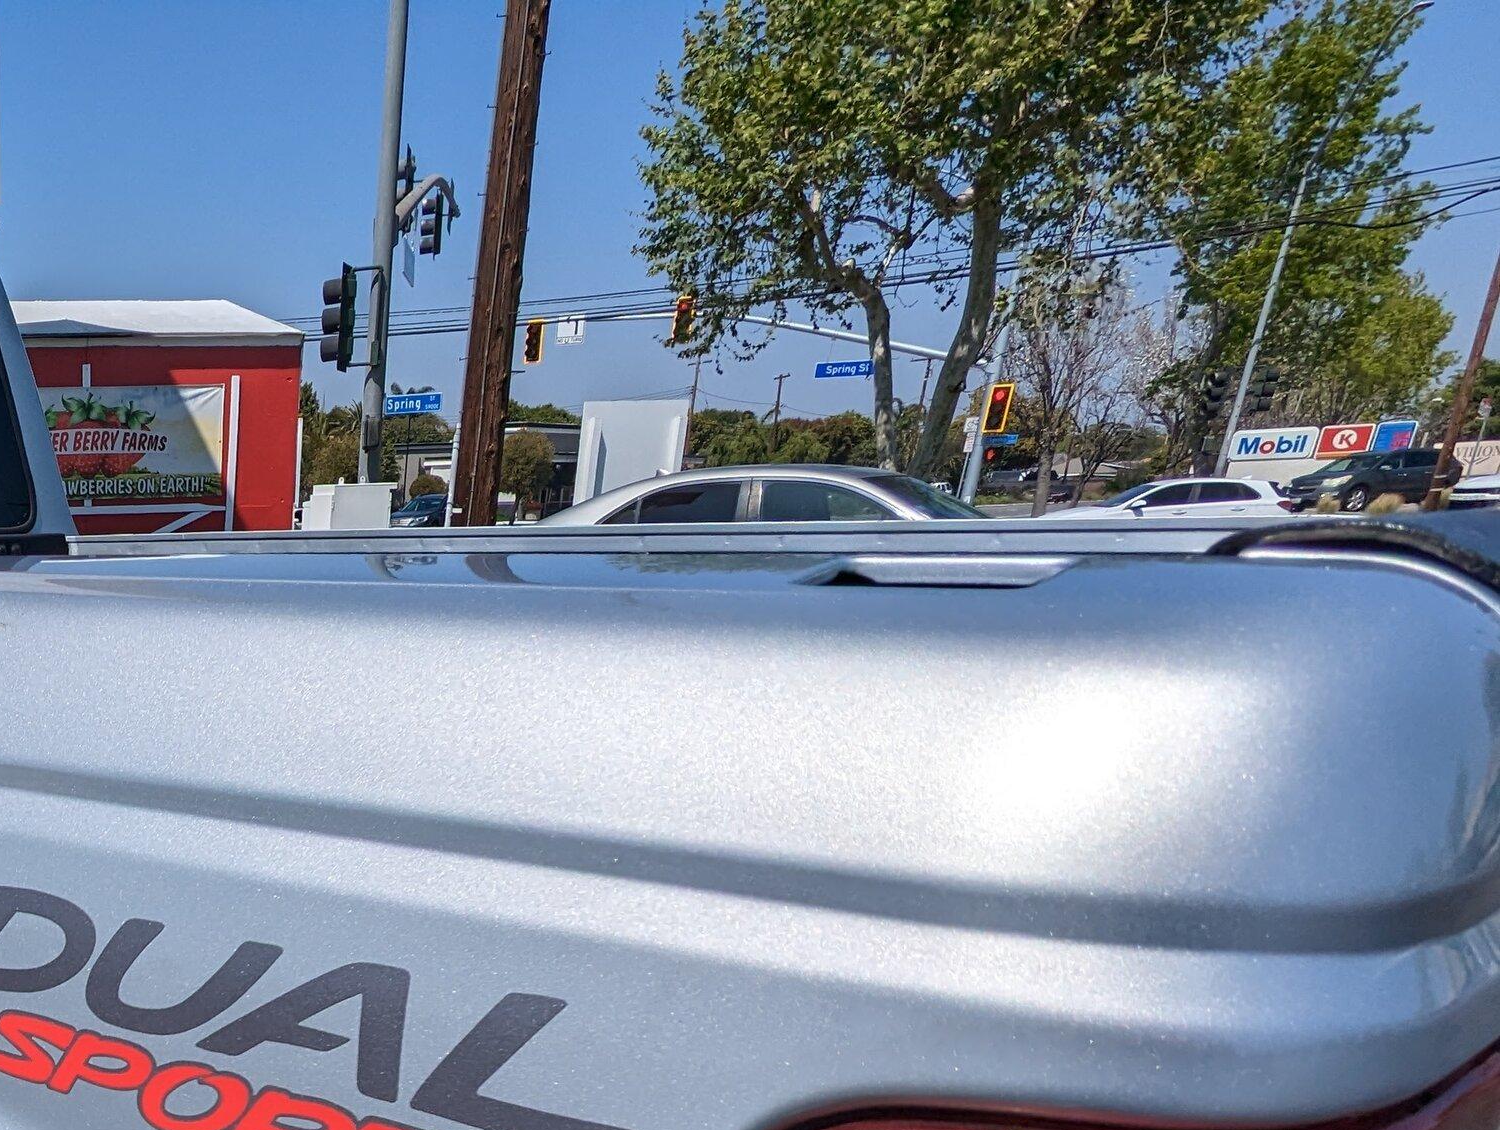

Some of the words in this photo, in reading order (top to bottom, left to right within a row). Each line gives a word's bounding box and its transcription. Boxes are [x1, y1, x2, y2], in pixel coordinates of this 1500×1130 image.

[826, 364, 857, 376] Spring
[859, 362, 870, 372] St
[387, 398, 421, 411] Spring
[50, 431, 69, 452] ER
[73, 430, 119, 452] BERRY
[122, 431, 167, 452] FARMS
[1237, 434, 1308, 455] Mobil
[137, 478, 155, 494] ON
